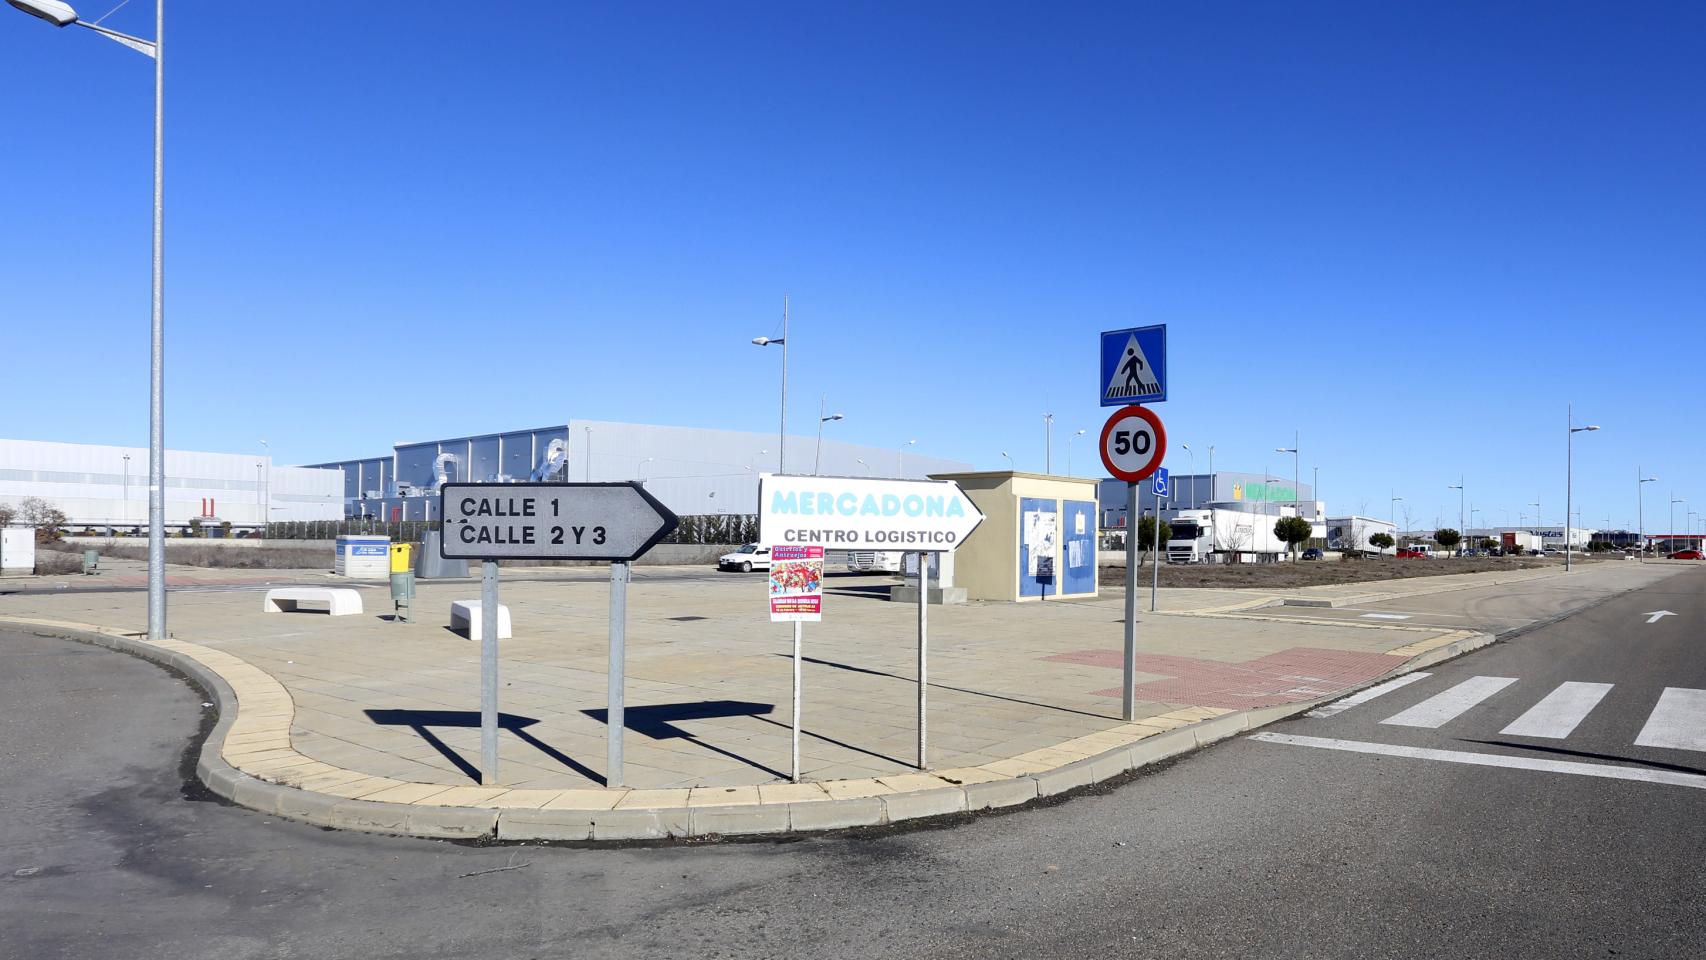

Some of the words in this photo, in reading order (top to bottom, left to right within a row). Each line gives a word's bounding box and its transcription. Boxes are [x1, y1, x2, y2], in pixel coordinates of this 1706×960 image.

[1115, 430, 1150, 455] 50
[460, 498, 536, 517] CALLE
[551, 498, 559, 516] 1
[771, 490, 965, 518] MERCADONA
[460, 526, 536, 544] CALLE
[550, 526, 564, 544] 2
[571, 526, 586, 544] Y
[593, 526, 606, 545] 3
[784, 529, 859, 543] CENTRO
[865, 530, 956, 544] LOGISTICO
